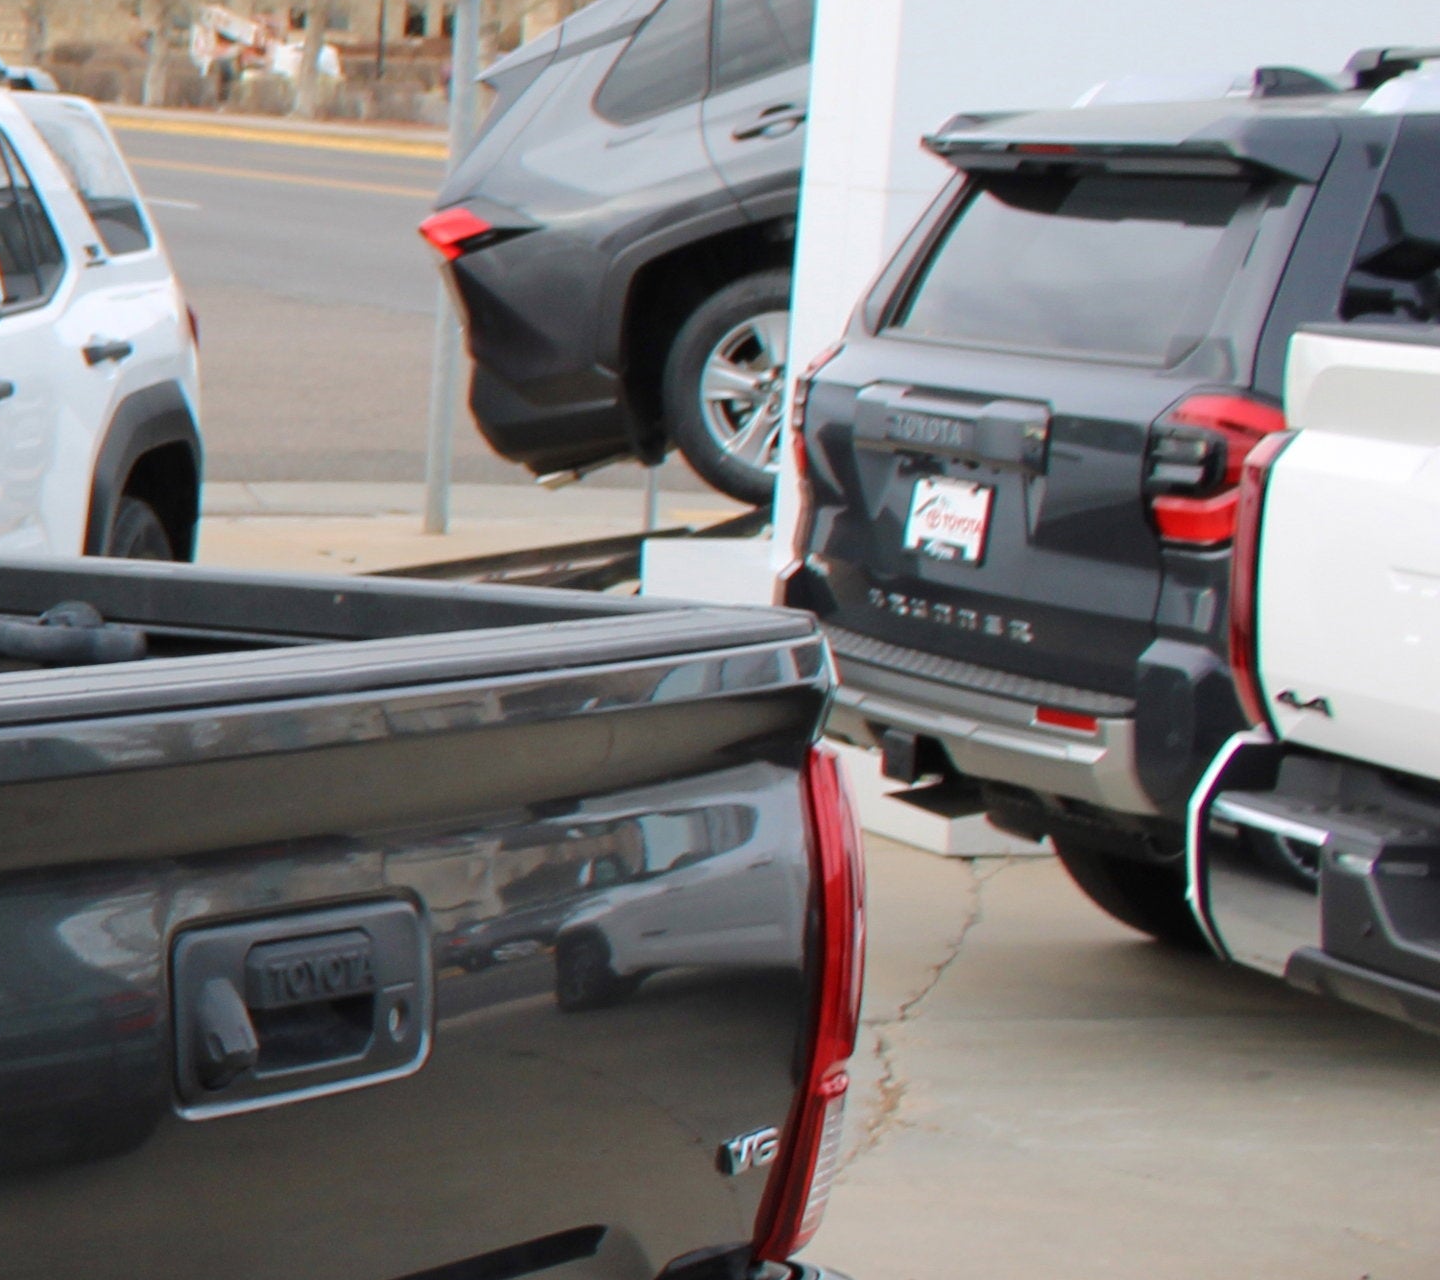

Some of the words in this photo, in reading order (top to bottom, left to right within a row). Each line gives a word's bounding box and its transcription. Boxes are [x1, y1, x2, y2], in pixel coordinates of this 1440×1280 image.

[892, 414, 964, 448] TOYOTA
[265, 951, 375, 1000] TOYOTA
[724, 1125, 781, 1177] V6
